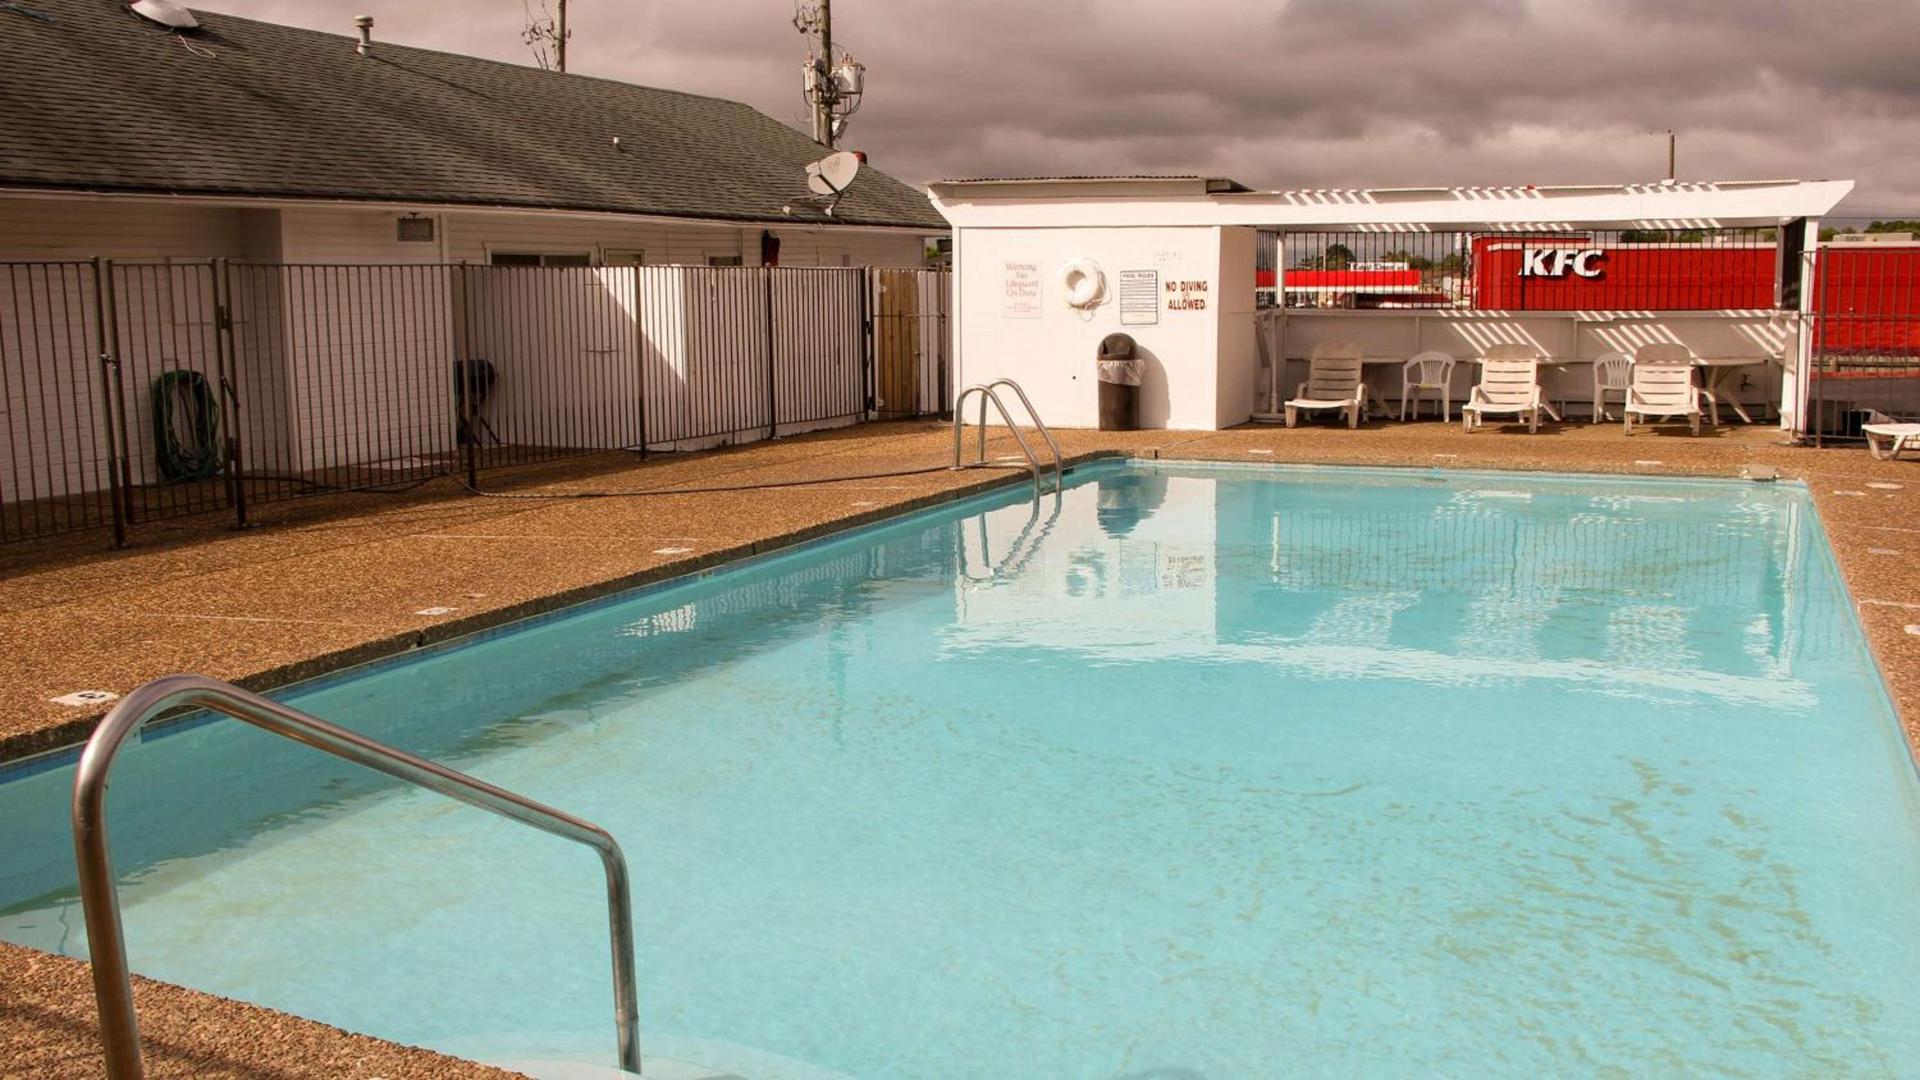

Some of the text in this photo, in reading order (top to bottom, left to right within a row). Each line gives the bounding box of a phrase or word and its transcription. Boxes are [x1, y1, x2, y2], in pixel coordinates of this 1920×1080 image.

[1517, 248, 1603, 277] KFC
[1165, 280, 1207, 292] NO DIVING
[1168, 299, 1205, 310] ALLOWED
